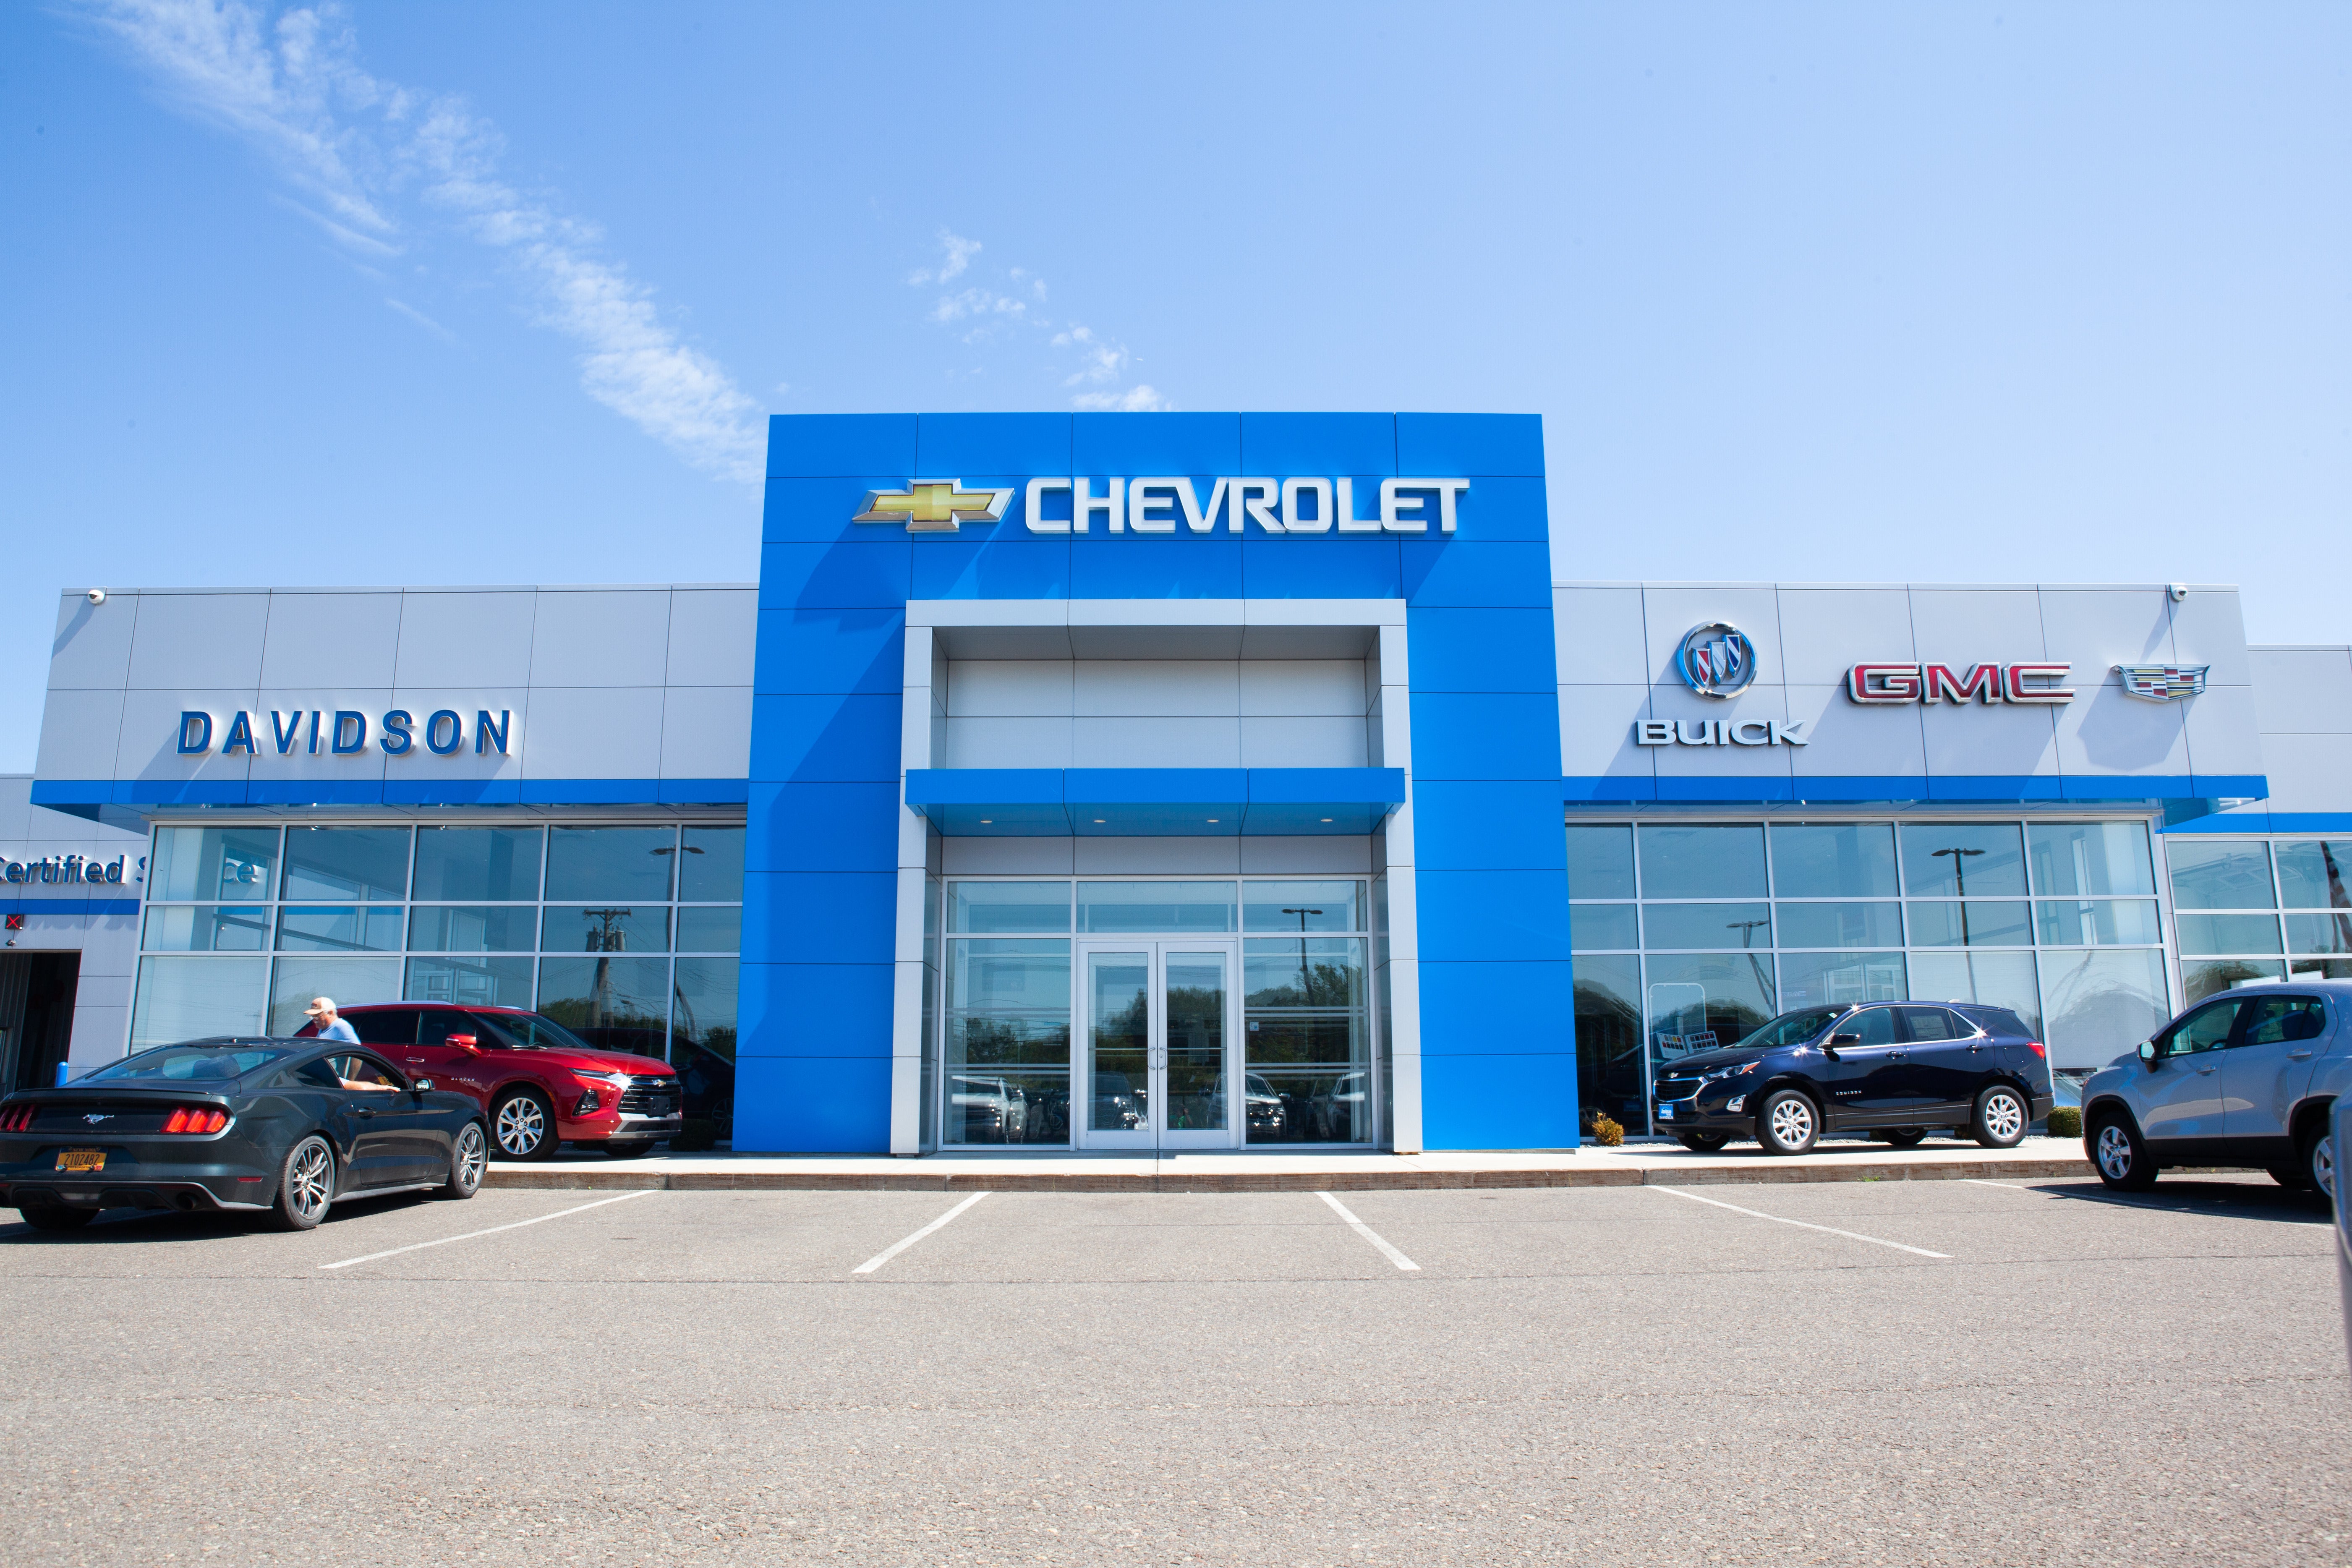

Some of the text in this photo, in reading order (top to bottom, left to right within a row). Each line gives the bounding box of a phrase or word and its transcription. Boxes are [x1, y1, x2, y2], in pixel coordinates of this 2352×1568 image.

[1025, 477, 1470, 534] CHEVROLET
[1848, 662, 2075, 704] GMC
[176, 709, 512, 756] DAVIDSON
[1636, 719, 1810, 746] BUICK
[64, 1153, 100, 1166] 2102482
